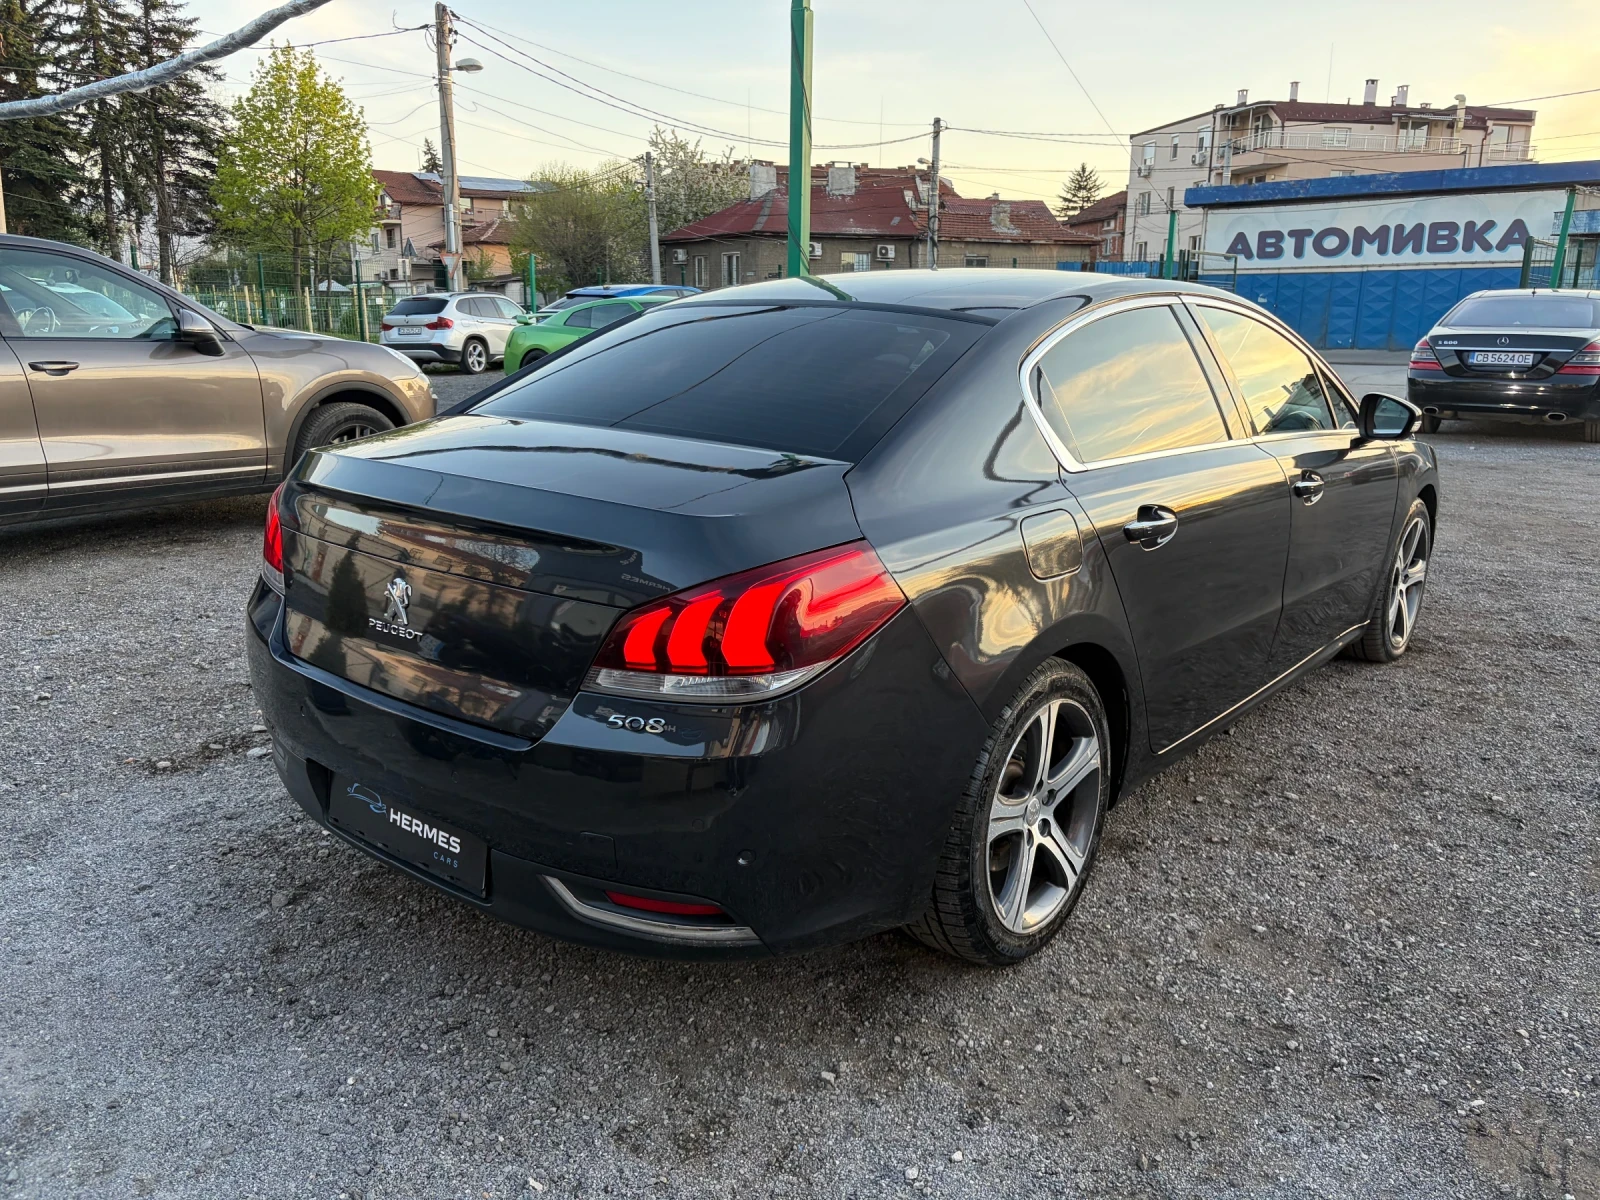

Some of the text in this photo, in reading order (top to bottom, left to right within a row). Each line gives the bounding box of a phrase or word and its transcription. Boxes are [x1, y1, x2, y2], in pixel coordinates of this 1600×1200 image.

[1224, 218, 1532, 260] АВТОМИВКА
[1475, 353, 1489, 363] CB
[1490, 353, 1516, 364] 5624
[368, 618, 423, 642] PEUGEOT
[607, 714, 666, 734] 508
[389, 808, 461, 854] HERMES
[433, 851, 459, 868] CARS
